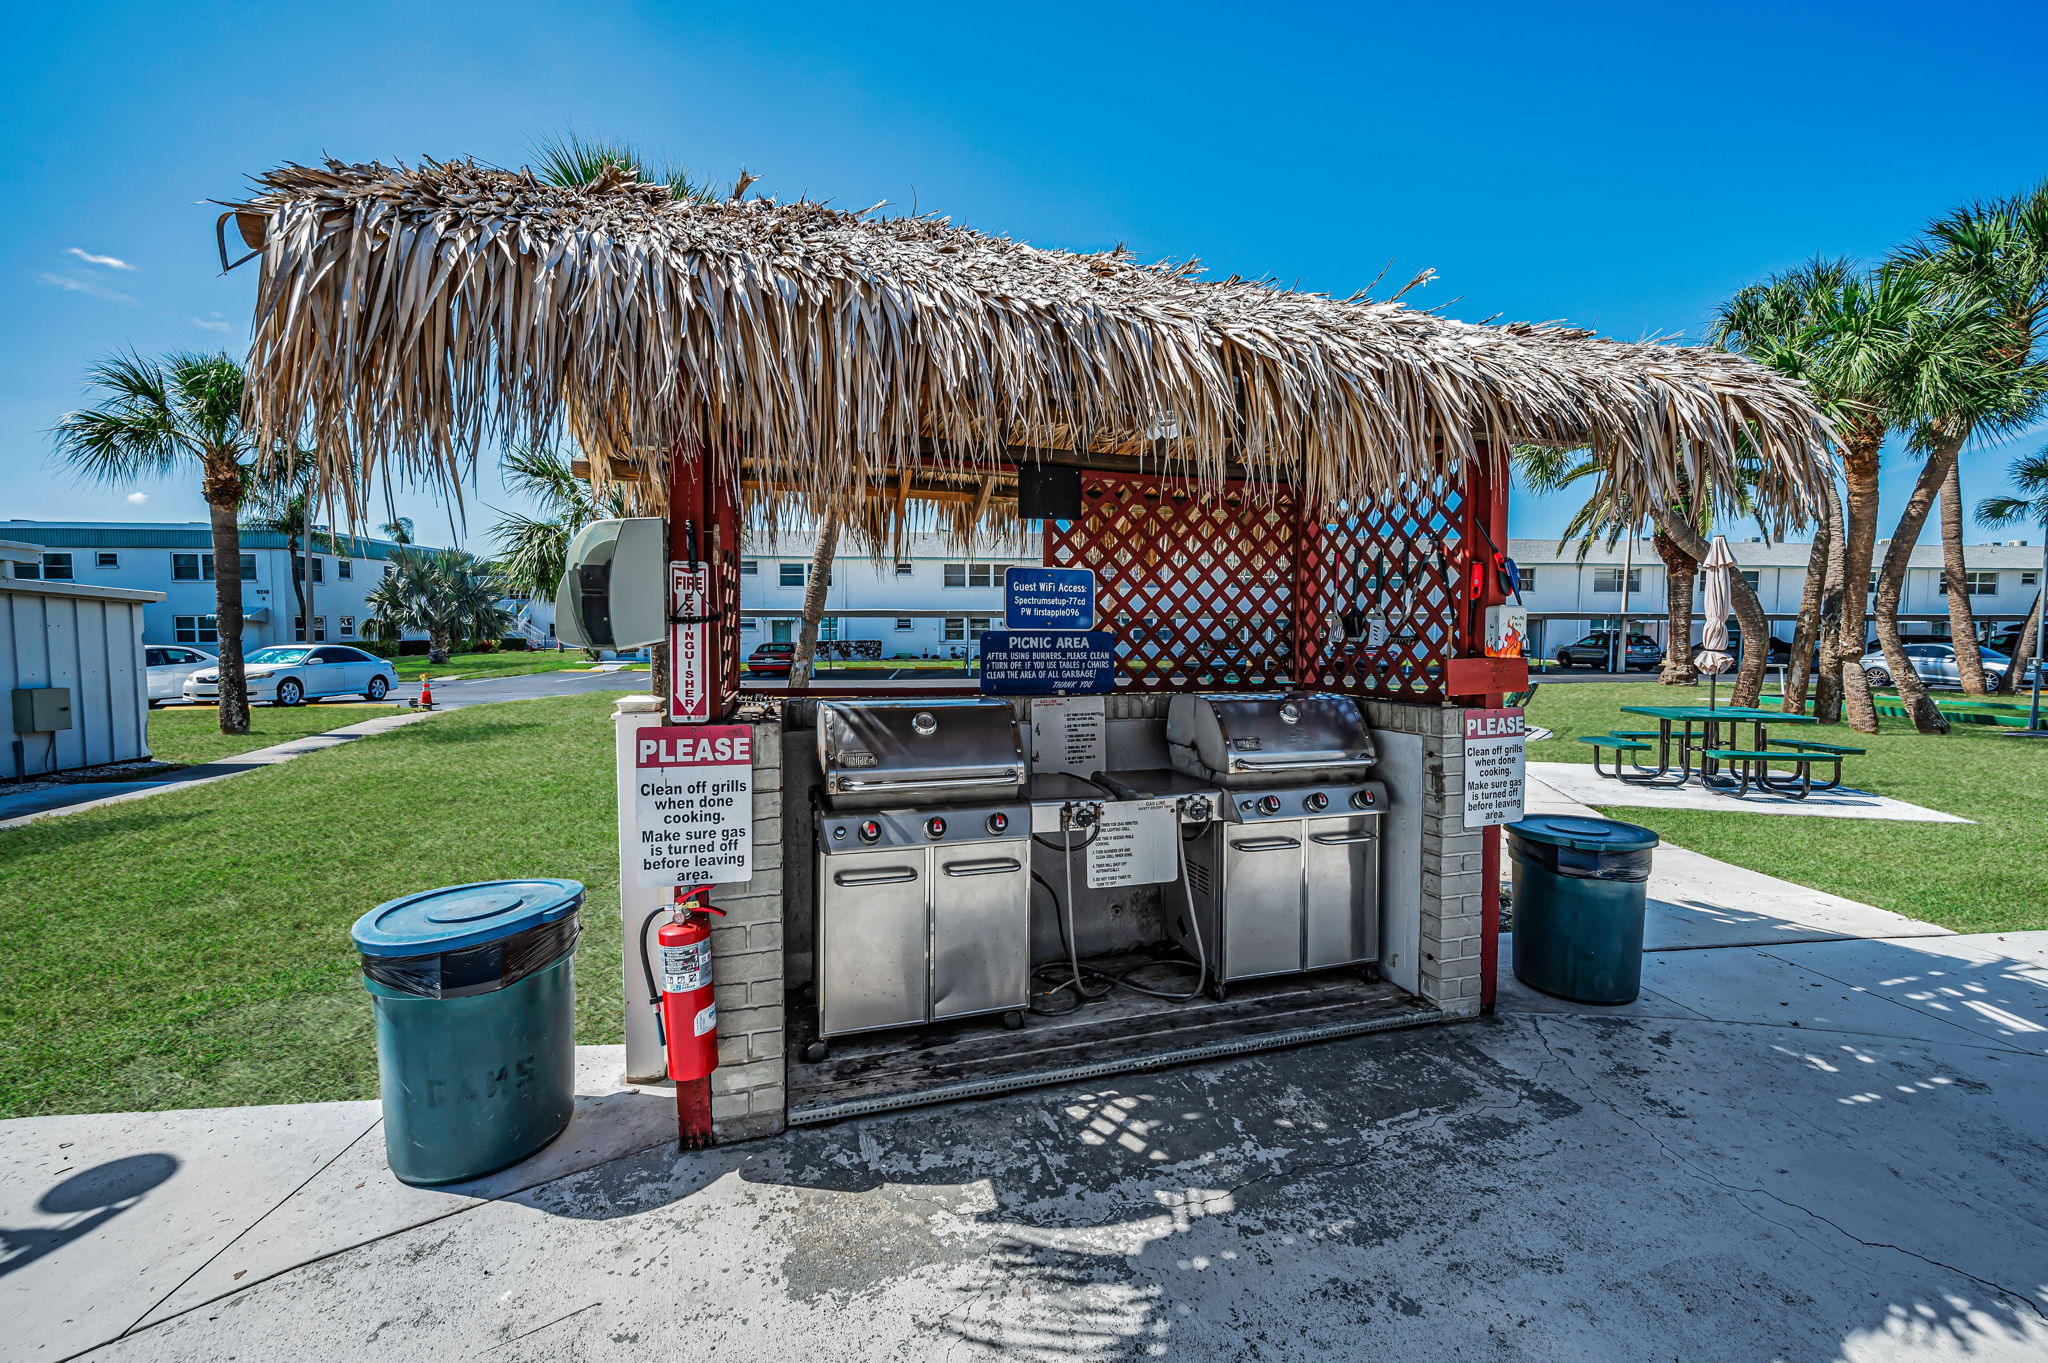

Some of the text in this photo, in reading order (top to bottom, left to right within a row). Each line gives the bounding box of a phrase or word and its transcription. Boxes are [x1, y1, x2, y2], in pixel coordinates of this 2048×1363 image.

[676, 576, 703, 590] FIRE
[1014, 582, 1088, 592] Guest WiFi Access:
[1014, 596, 1086, 606] Spectrumsetup-77cd
[1021, 608, 1080, 618] PW firstapple096
[1008, 636, 1090, 649] PICNIC AREA
[987, 652, 1008, 660] AFTER
[1011, 652, 1029, 660] USING
[1010, 661, 1022, 669] OFF.
[1025, 661, 1031, 669] IF
[1033, 661, 1044, 669] YOU
[1059, 661, 1080, 669] TABLES
[987, 671, 1005, 679] CLEAN
[1007, 671, 1018, 679] THE
[1062, 670, 1096, 678] GARBAGE!
[1466, 716, 1524, 736] PLEASE
[639, 737, 750, 763] PLEASE
[1467, 744, 1522, 757] Clean off grills
[1475, 756, 1516, 767] when done
[1480, 767, 1512, 777] cooking.
[640, 780, 747, 796] Clean off grills
[1468, 779, 1522, 791] Make sure gas
[1472, 788, 1518, 800] is turned off
[654, 796, 734, 810] when done
[1468, 799, 1520, 811] before leaving
[664, 811, 725, 824] cooking.
[1486, 810, 1505, 820] area.
[642, 828, 746, 843] Make sure gas
[650, 839, 738, 856] is turned off
[643, 853, 745, 870] before leaving
[677, 870, 713, 881] area.
